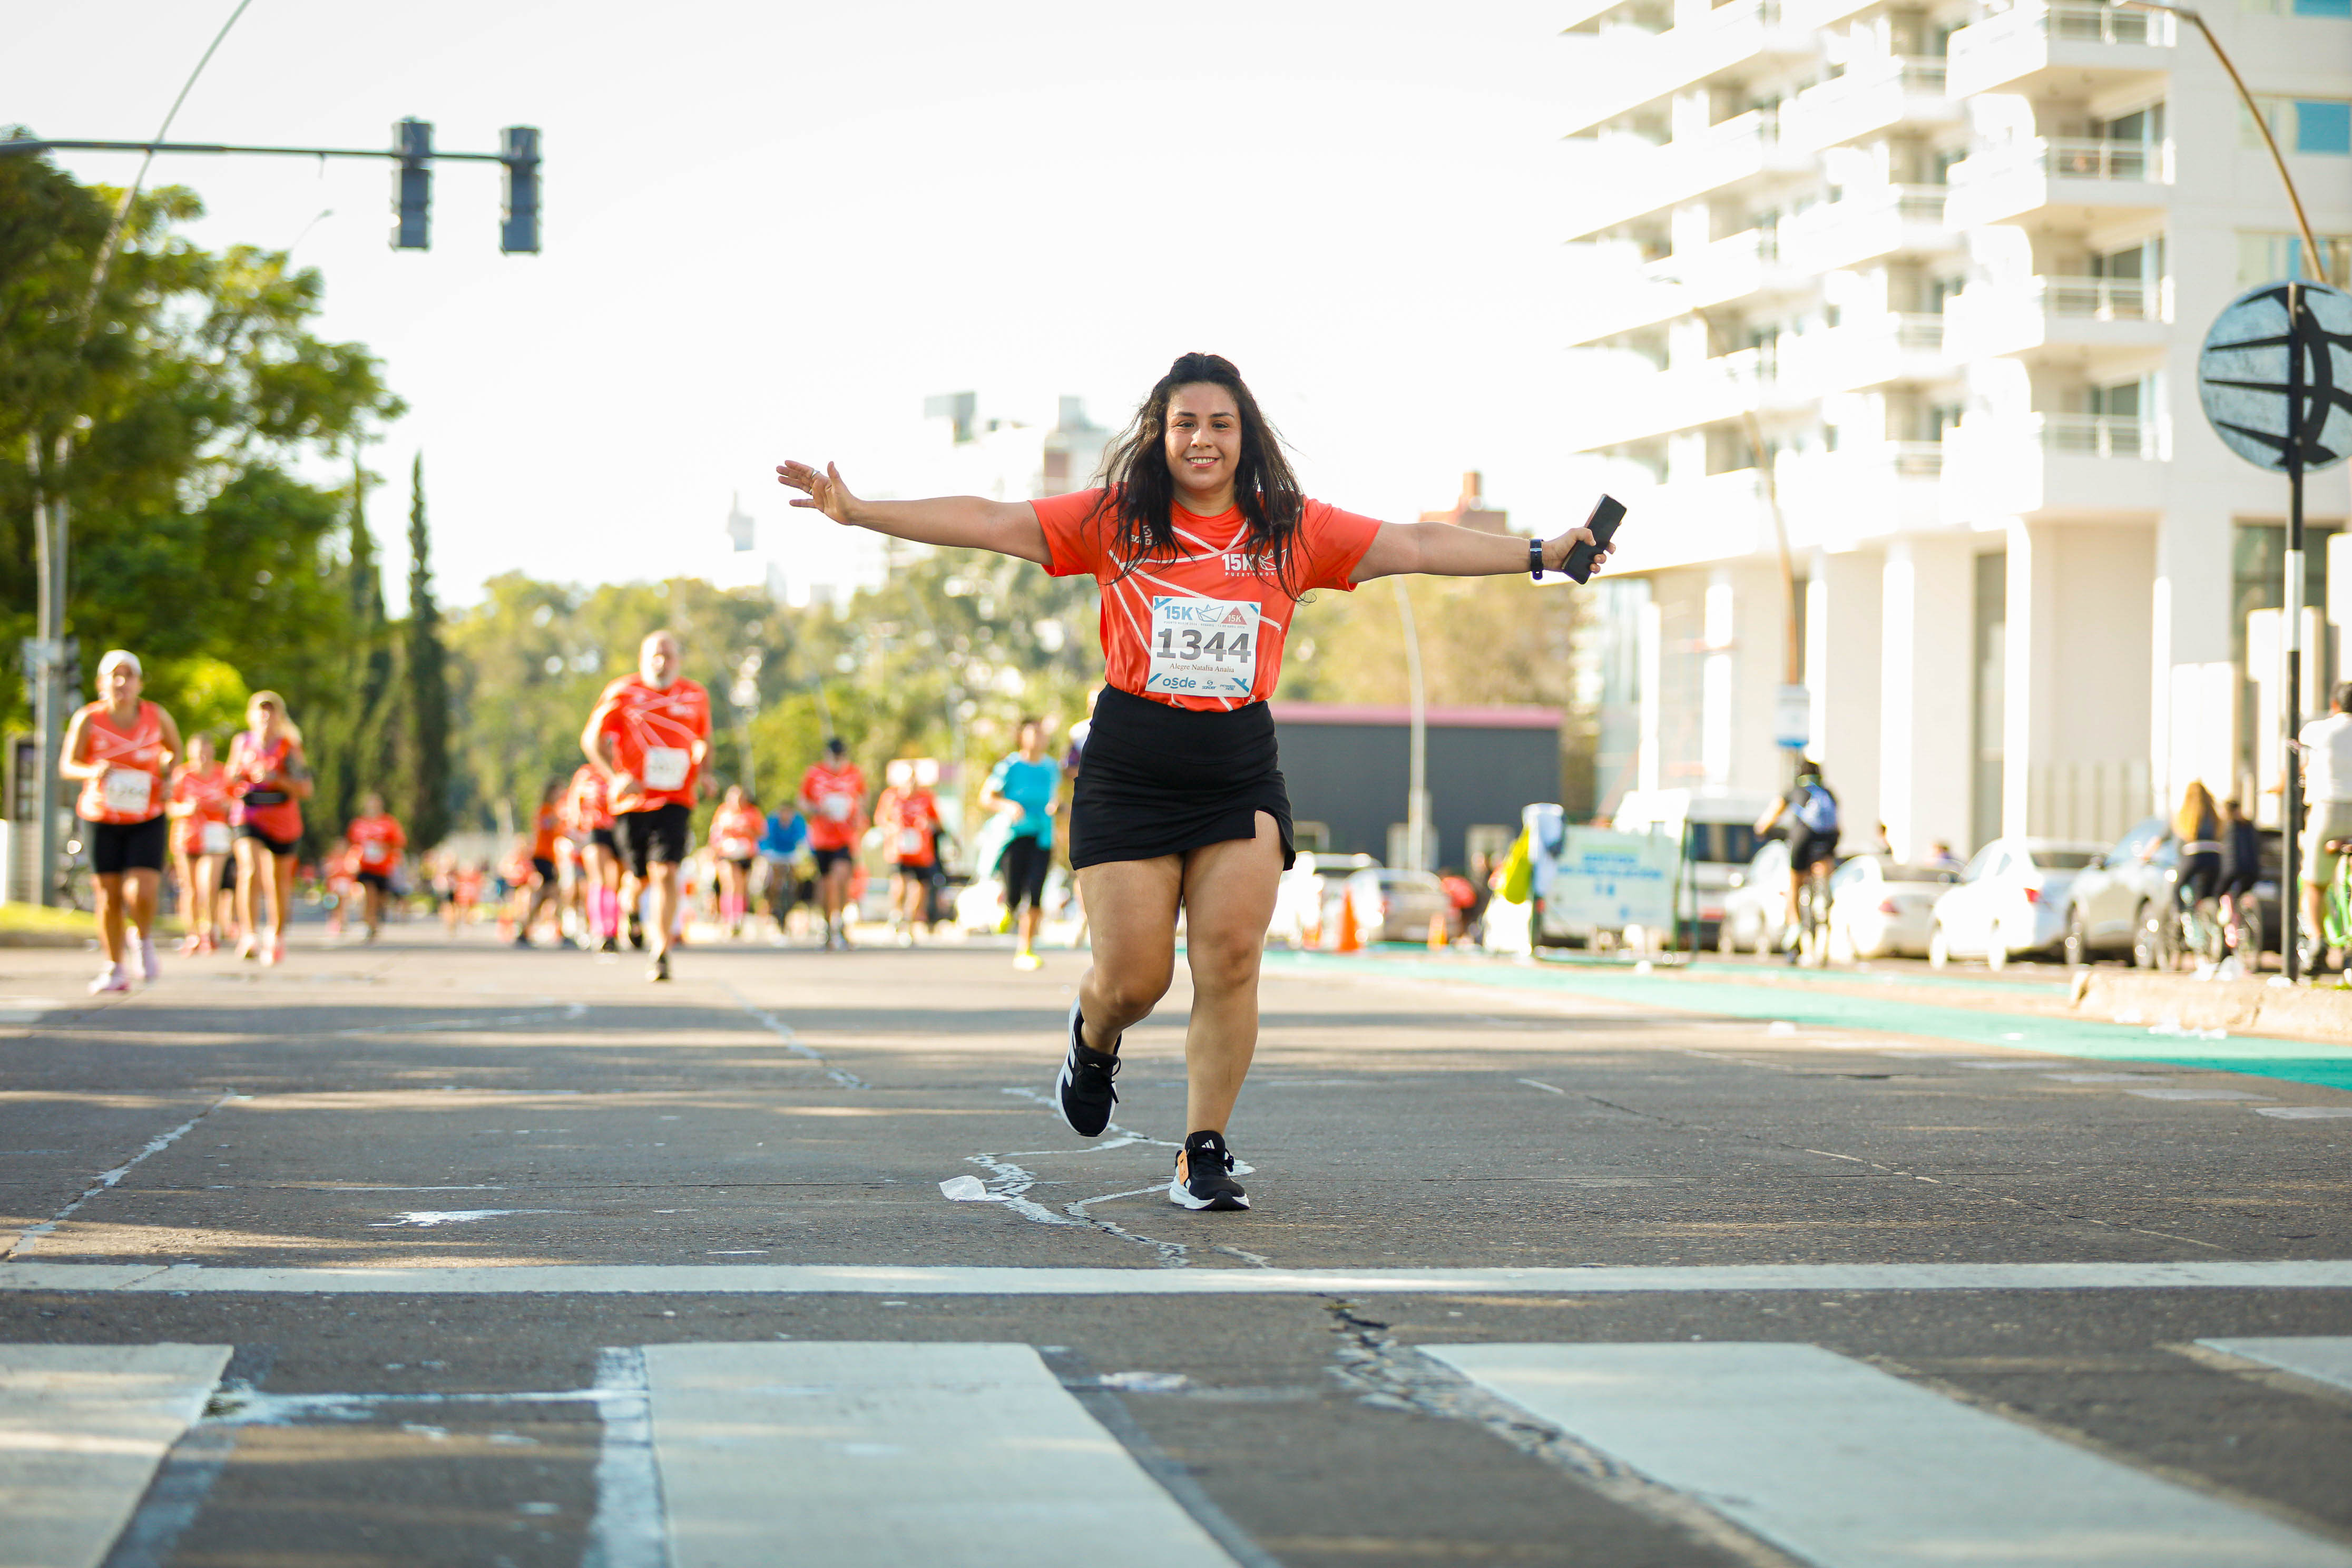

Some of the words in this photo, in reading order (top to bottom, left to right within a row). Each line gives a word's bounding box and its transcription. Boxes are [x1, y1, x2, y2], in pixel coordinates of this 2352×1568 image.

[1222, 554, 1256, 571] 15K
[1164, 606, 1194, 620] 15K
[1228, 614, 1241, 623] 15K
[1157, 628, 1251, 663] 1344
[1170, 663, 1190, 671] Alegre
[1162, 677, 1197, 689] osde
